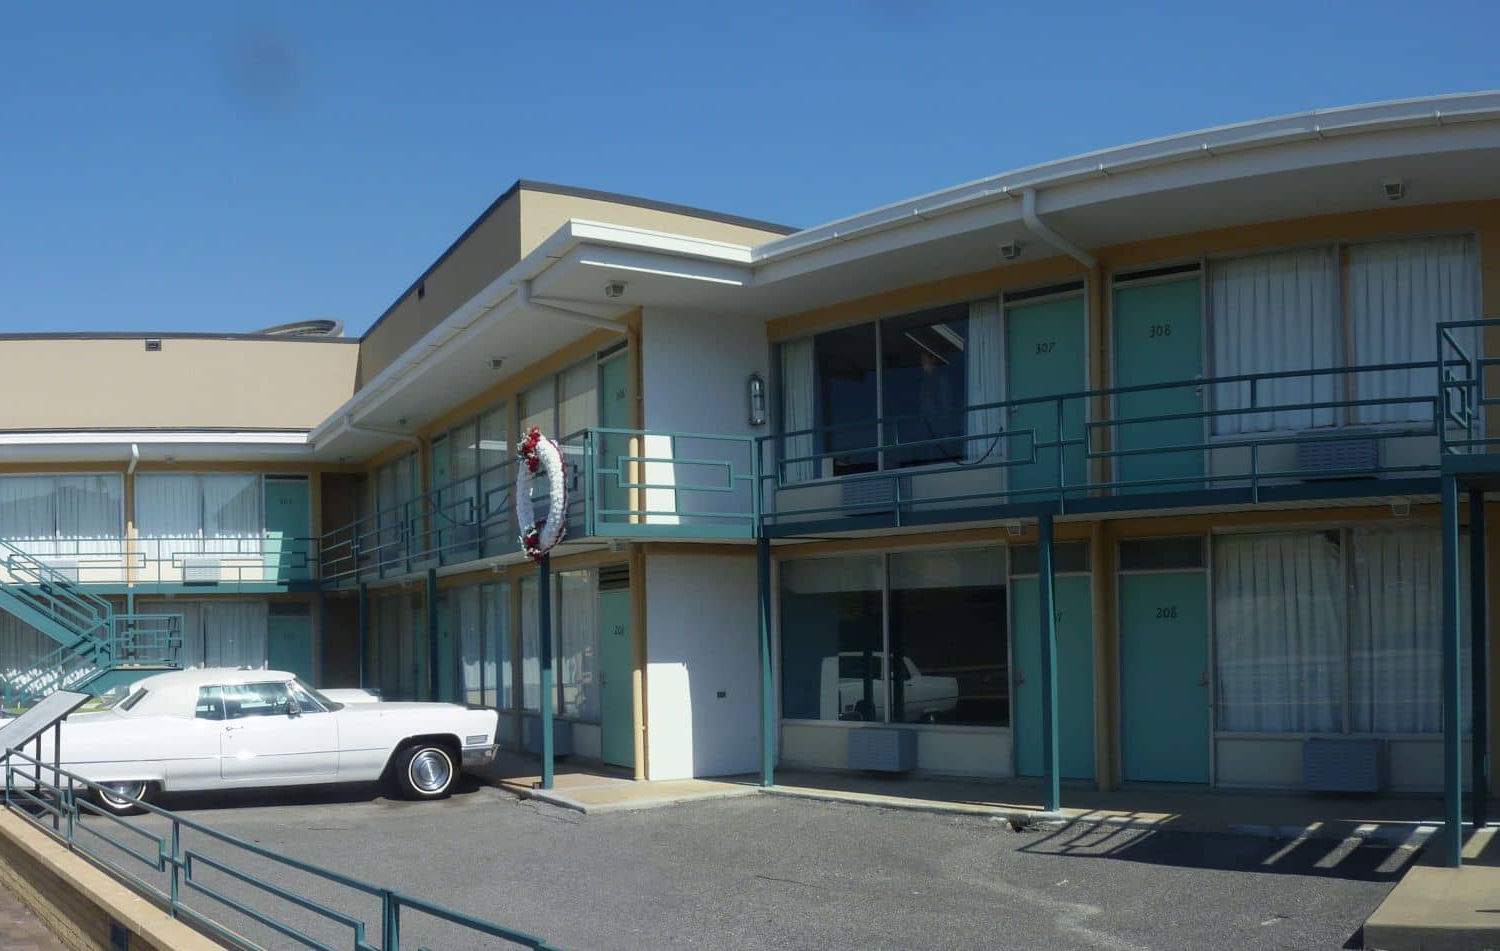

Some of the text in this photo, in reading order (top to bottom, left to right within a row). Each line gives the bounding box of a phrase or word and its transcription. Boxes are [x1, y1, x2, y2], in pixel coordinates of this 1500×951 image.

[1149, 323, 1172, 338] 308
[1036, 341, 1056, 355] 307
[1156, 606, 1177, 619] 208
